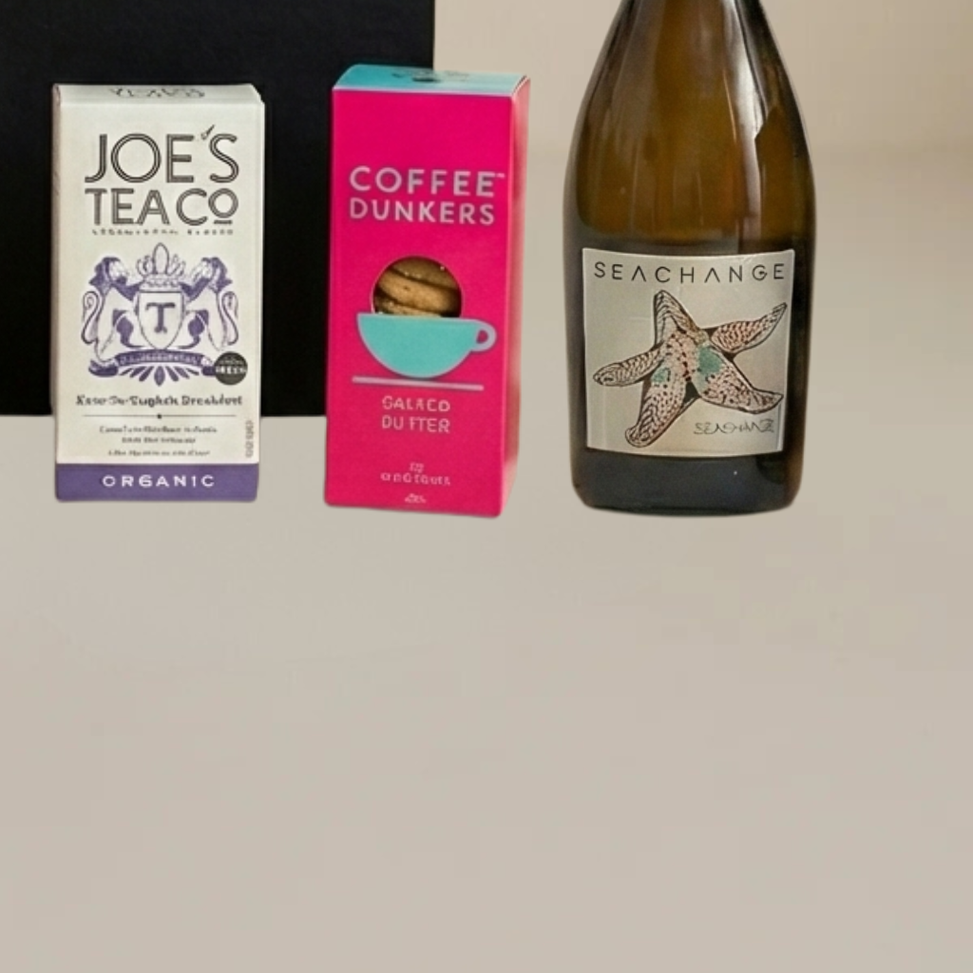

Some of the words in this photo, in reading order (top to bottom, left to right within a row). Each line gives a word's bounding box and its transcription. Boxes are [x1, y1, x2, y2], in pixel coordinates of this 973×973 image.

[84, 124, 239, 183] JOE'S
[349, 197, 495, 226] DUNKERS
[593, 261, 785, 284] SEACHANGE
[101, 474, 215, 488] ORGANIC
